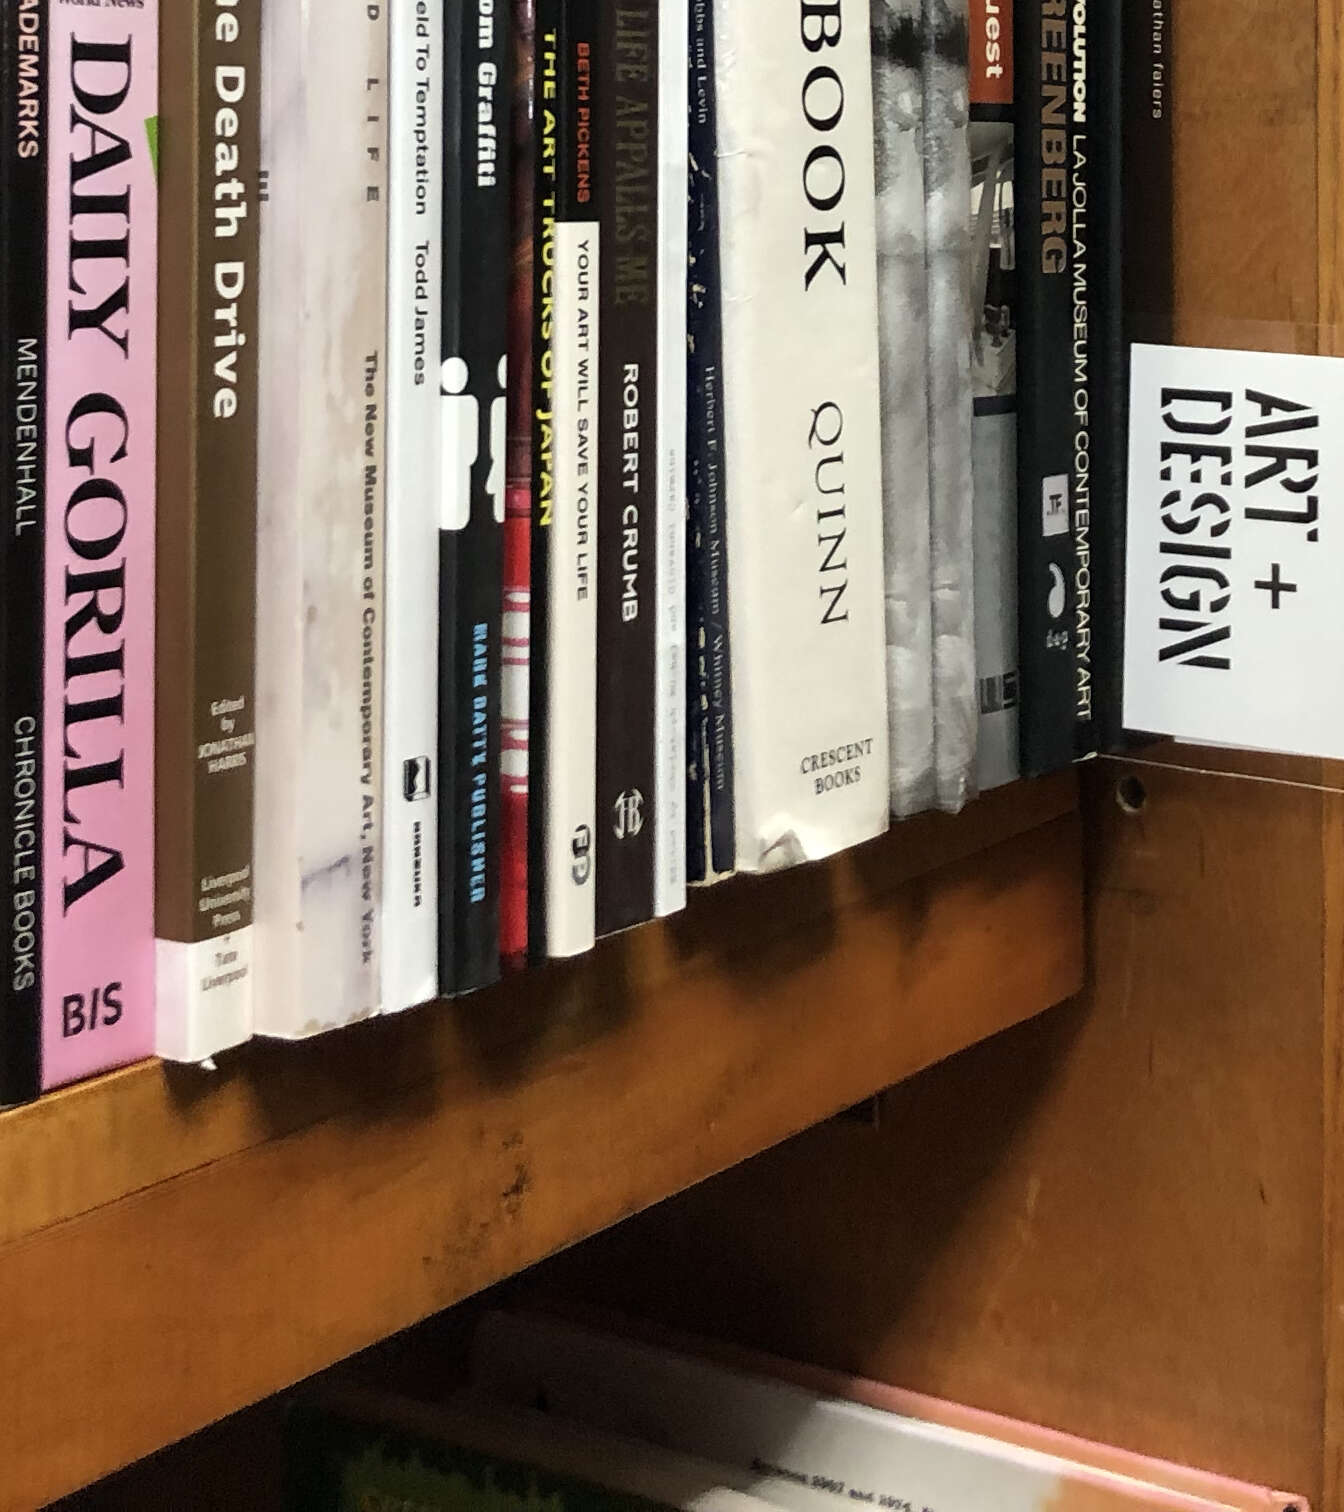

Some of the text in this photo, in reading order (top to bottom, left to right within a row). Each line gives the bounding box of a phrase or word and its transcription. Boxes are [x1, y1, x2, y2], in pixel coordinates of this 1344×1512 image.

[413, 43, 431, 75] To
[476, 61, 499, 188] Graffiti
[541, 28, 558, 178] THE ART
[693, 30, 710, 124] and Levin
[67, 31, 134, 361] DAILY
[213, 64, 246, 240] Death
[366, 76, 382, 205] LIFE
[410, 77, 432, 216] Temptation
[1072, 134, 1089, 168] LA
[412, 239, 432, 303] Todd
[1072, 172, 1089, 258] JOLLA
[211, 260, 246, 422] Drive
[412, 306, 432, 387] James
[575, 42, 591, 601] BETH PICKENS YOUR ART WILL SAVE YOUR LIFE
[1072, 262, 1089, 383] MUSEUM
[13, 337, 38, 536] MENDENHALL
[1073, 387, 1089, 427] OF
[620, 363, 640, 623] ROBERT CRUMB
[704, 365, 725, 709] Herbert Johnson Museum Whitney
[807, 400, 850, 625] QUINN
[1074, 430, 1092, 662] CONTEMPORARY
[1158, 386, 1320, 672] ART DESIGN
[61, 391, 129, 918] GORILLA
[358, 349, 379, 965] The New Museum of Contemporary New York
[470, 622, 490, 688] MARK
[1075, 666, 1092, 722] ART
[12, 714, 37, 883] CHRONICLE
[468, 772, 489, 904] PUBLISHER
[814, 775, 863, 796] BOOKS
[12, 890, 37, 991] BOOKS
